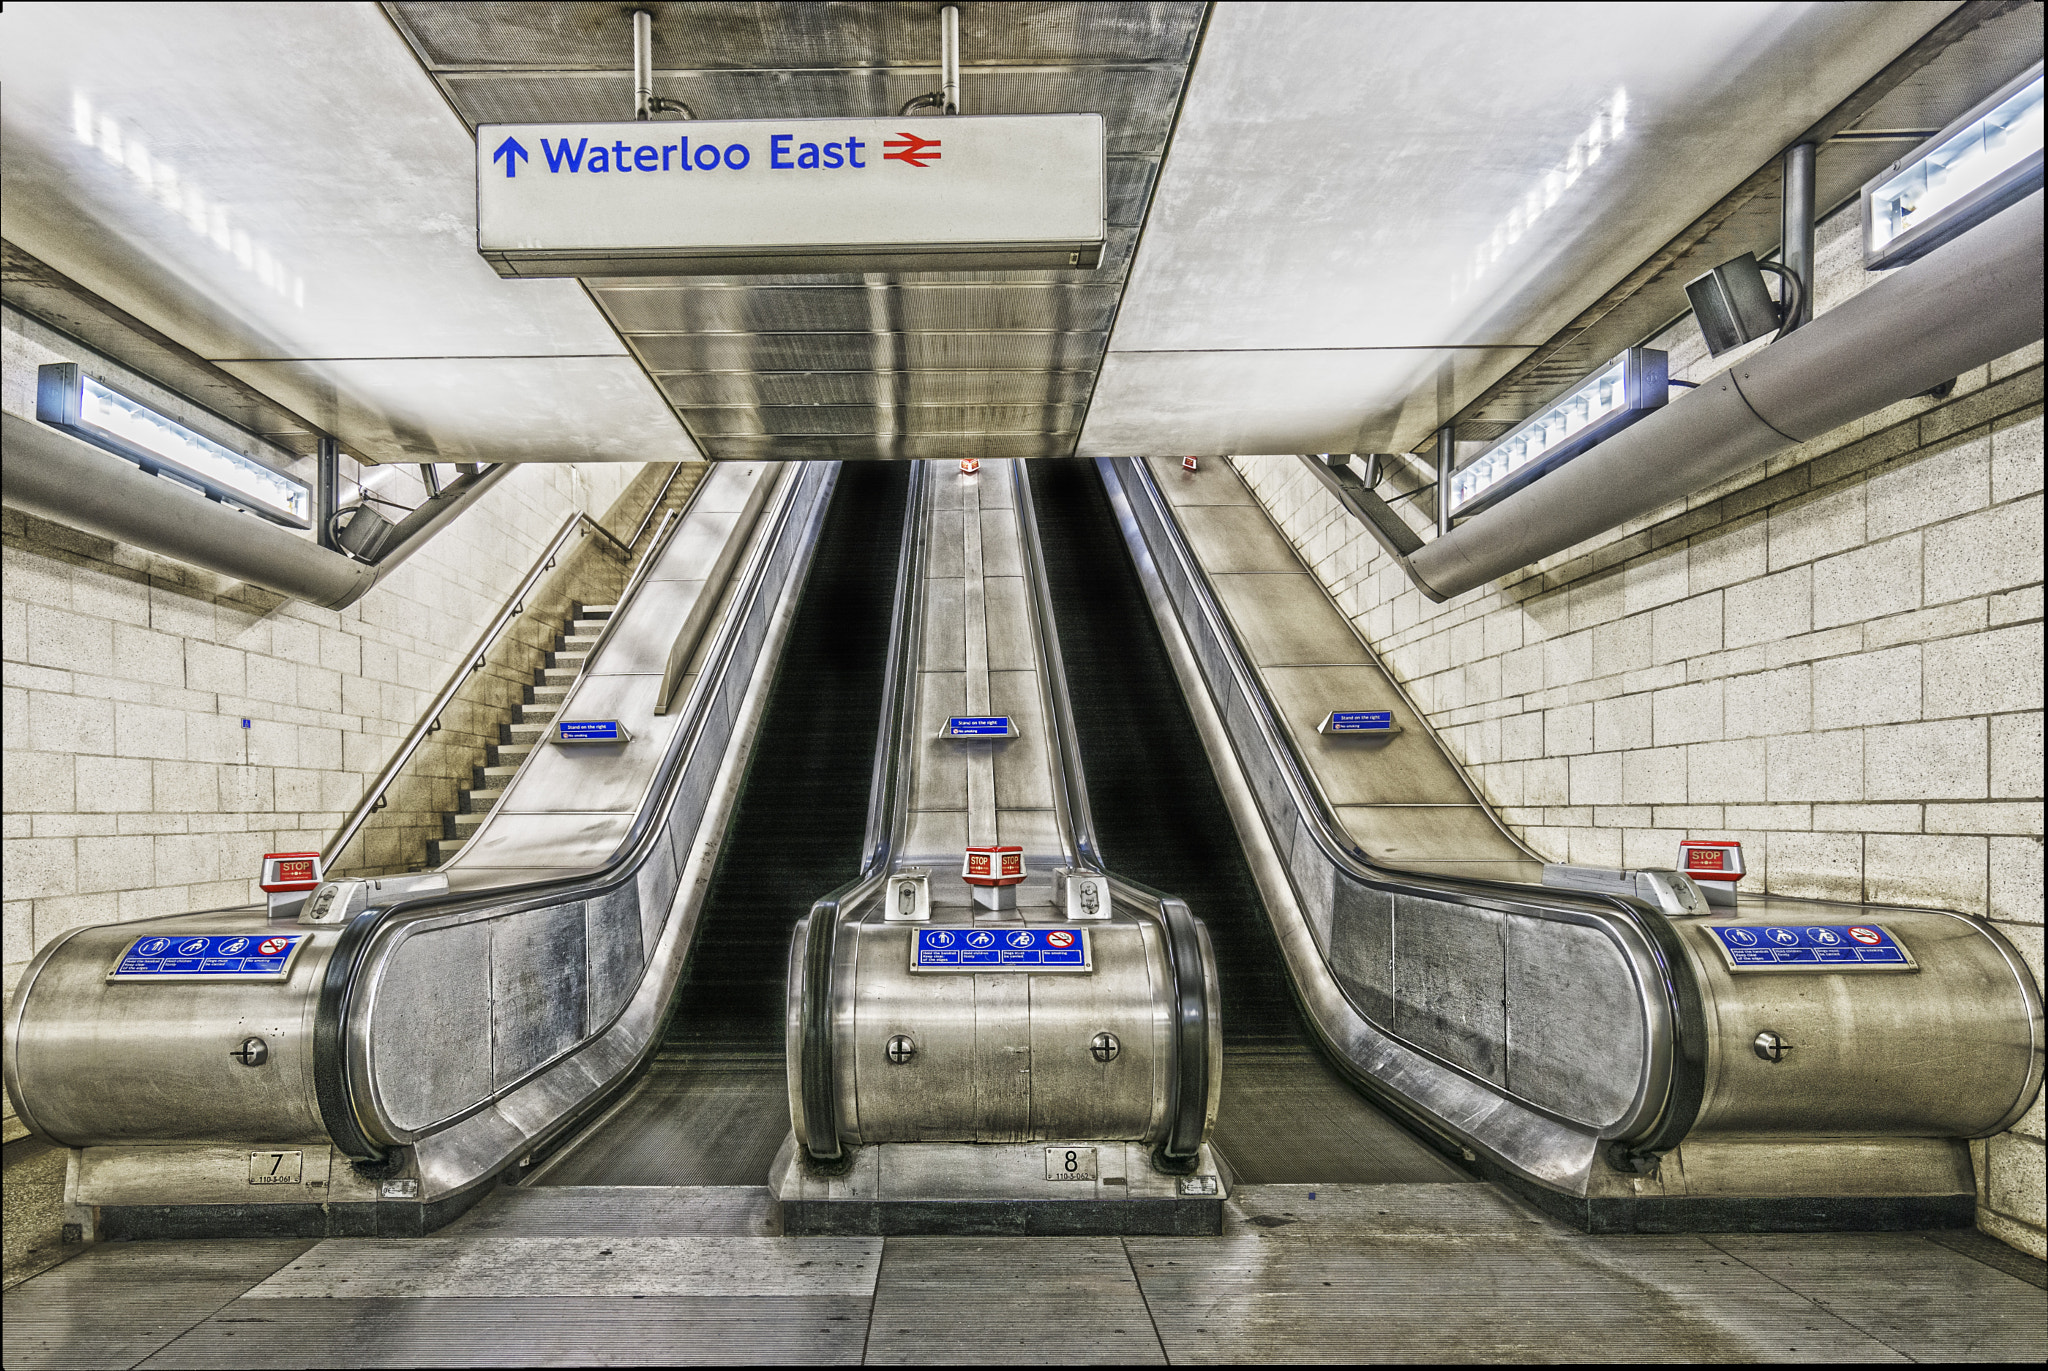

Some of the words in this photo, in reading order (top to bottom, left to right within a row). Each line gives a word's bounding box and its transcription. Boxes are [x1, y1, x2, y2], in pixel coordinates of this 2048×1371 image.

[540, 136, 750, 174] Waterloo
[770, 134, 866, 170] East
[1692, 850, 1721, 860] STOP
[970, 856, 988, 865] STOP
[1002, 856, 1019, 865] STOP
[283, 862, 310, 871] STOP
[270, 1154, 284, 1176] 7
[1064, 1150, 1078, 1172] 8
